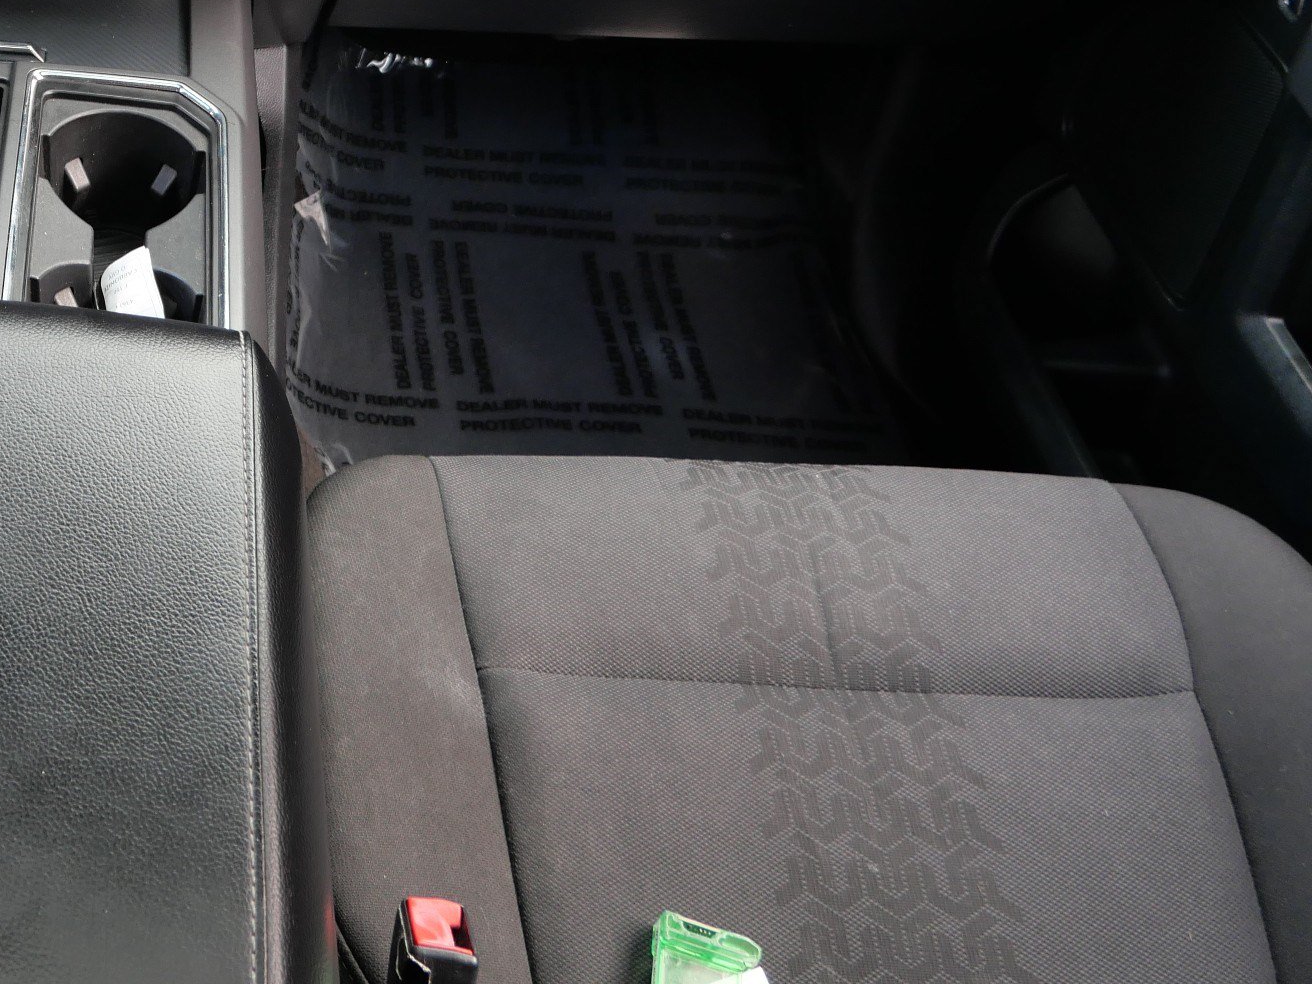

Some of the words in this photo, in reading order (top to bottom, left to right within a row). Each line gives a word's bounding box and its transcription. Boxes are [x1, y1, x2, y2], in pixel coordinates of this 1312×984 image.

[314, 379, 360, 403] MUST
[363, 392, 440, 410] REMOVE
[456, 398, 529, 414] DEALER
[587, 400, 664, 417] REMOVE
[353, 411, 416, 427] COVER
[459, 416, 574, 432] PROTECTIVE
[578, 418, 643, 434] COVER
